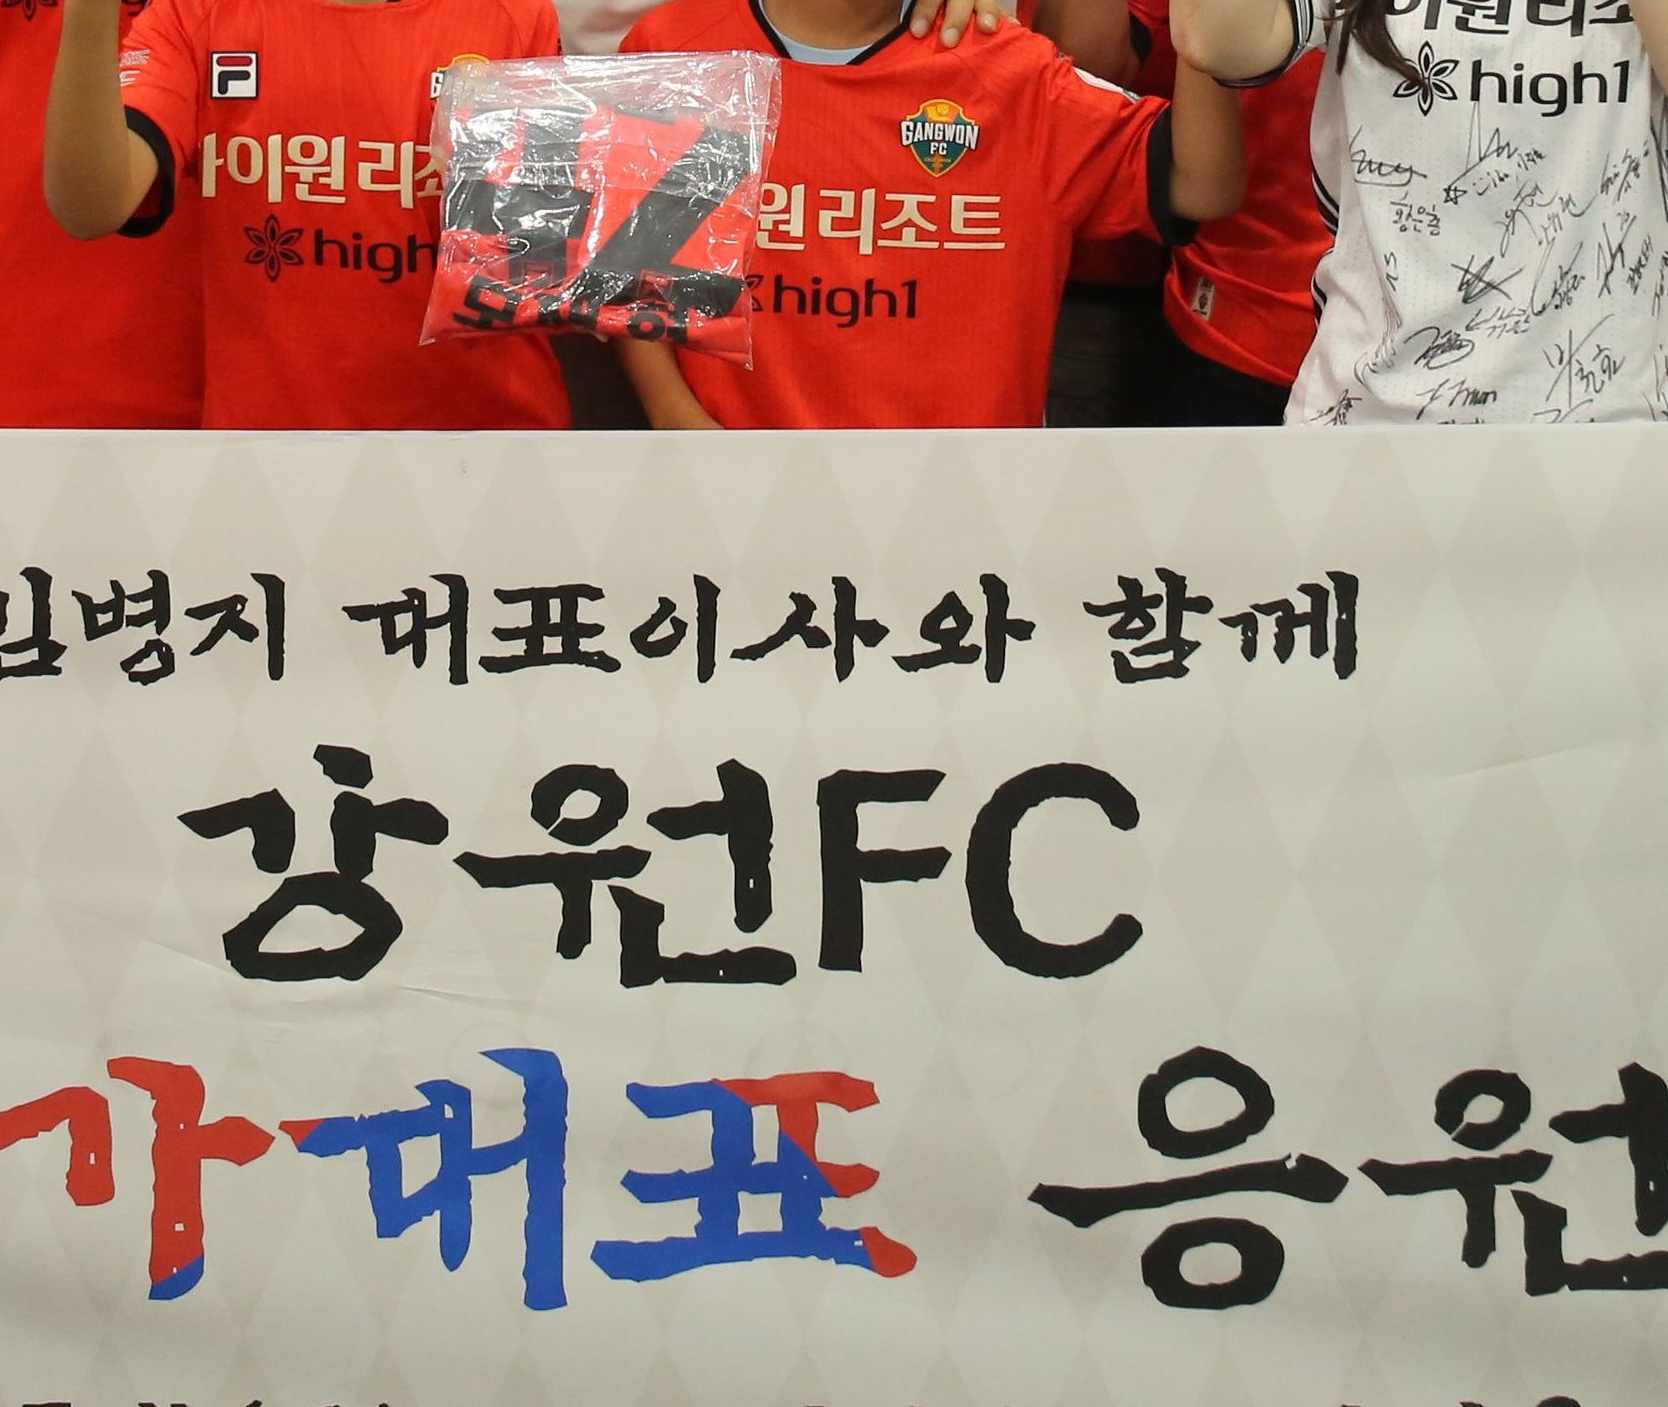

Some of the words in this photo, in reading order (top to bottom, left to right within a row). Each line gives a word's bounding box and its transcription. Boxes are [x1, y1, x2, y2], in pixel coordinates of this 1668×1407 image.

[1471, 59, 1630, 118] high1
[901, 120, 980, 150] GANGWON
[930, 142, 947, 155] FC
[773, 274, 918, 328] high1
[342, 573, 1036, 686] 대표이사와
[1082, 567, 1360, 684] 함께
[177, 745, 1144, 989] 강원FC
